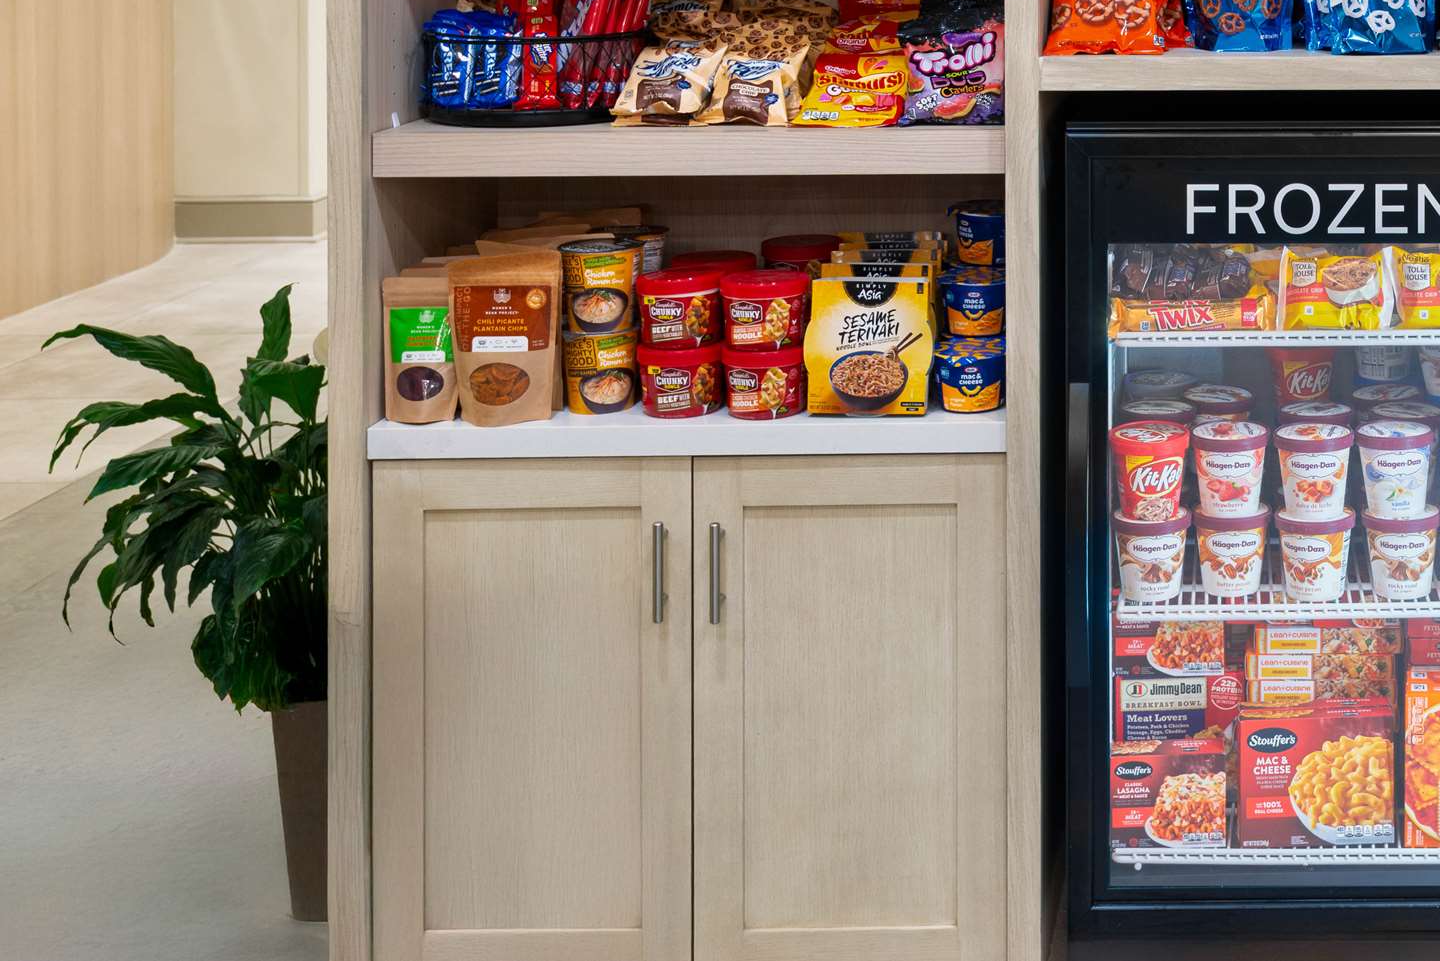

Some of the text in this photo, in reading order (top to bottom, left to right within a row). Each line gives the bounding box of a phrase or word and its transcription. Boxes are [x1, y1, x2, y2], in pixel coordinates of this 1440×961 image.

[912, 32, 995, 74] Trolli
[945, 70, 969, 78] SOUR
[731, 83, 769, 93] CHOCOLATE
[584, 269, 616, 278] Chicken
[858, 290, 882, 300] Asia
[651, 306, 682, 317] CHUNKY
[731, 309, 760, 318] CHUNKY
[842, 309, 897, 330] SESAME
[1148, 306, 1214, 330] TWIX
[652, 326, 671, 334] BEEF
[838, 322, 900, 345] TERIYAKI
[733, 331, 762, 340] NOODLE
[656, 376, 689, 386] CHUNKY
[729, 377, 756, 387] CHUNKY
[657, 396, 678, 404] BEEF
[732, 399, 759, 407] NOODLE
[1206, 461, 1251, 471] Häagen-Dazs
[1291, 460, 1337, 471] Häagen-Dazs
[1377, 460, 1422, 469] Häagen-Dazs
[1133, 543, 1178, 553] Häagen-Dazs
[1212, 539, 1257, 549] Häagen-Dazs
[1381, 541, 1425, 550] Häagen-Dazs
[1150, 682, 1202, 696] Jimmy Dean
[1127, 713, 1188, 723] Meat Lovers
[1249, 734, 1296, 747] Stouffer's
[1256, 755, 1288, 766] MAC &
[1116, 765, 1152, 776] Stouffer's
[1253, 765, 1291, 775] CHEESE
[1117, 786, 1151, 794] LASAGNA
